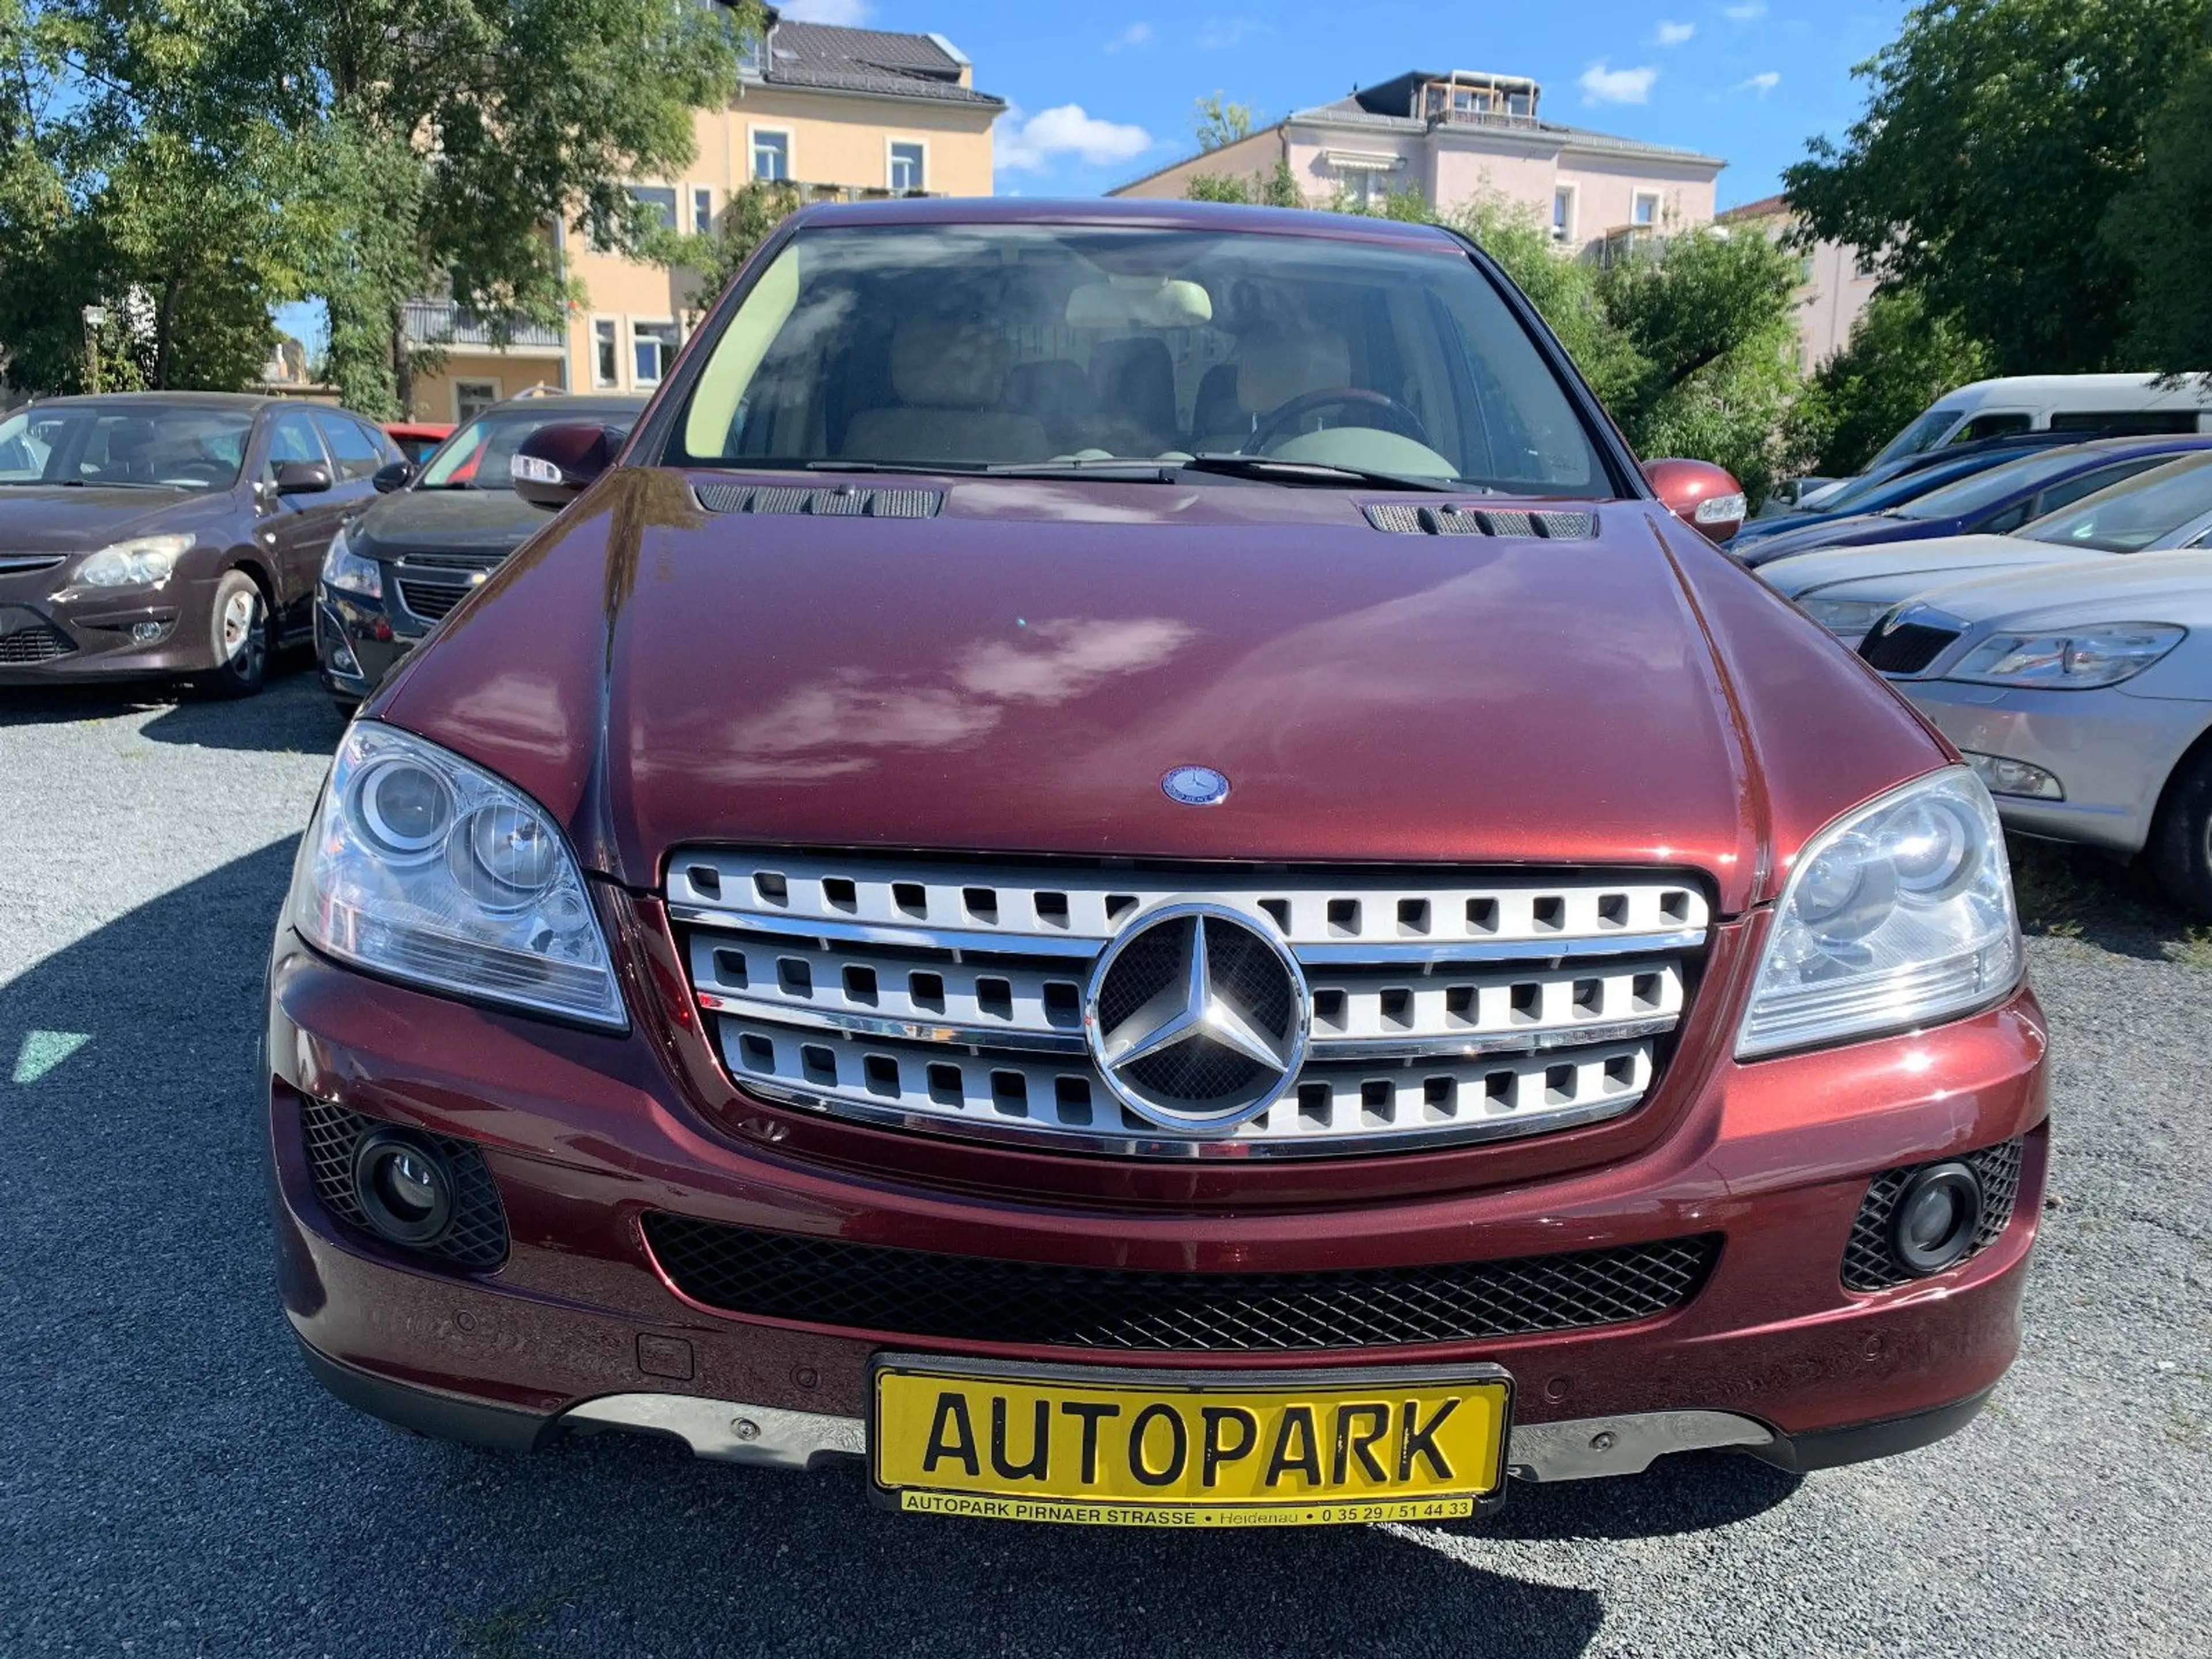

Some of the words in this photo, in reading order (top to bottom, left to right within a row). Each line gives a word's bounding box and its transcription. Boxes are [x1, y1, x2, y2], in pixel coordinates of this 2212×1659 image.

[922, 1392, 1460, 1487] AUTOPARK
[907, 1495, 1009, 1516] AUTOPARK
[1016, 1505, 1100, 1521] PIRNAER
[1107, 1510, 1195, 1525] STRASSE
[1323, 1509, 1331, 1521] 0
[1338, 1508, 1357, 1521] 35
[1363, 1506, 1383, 1520] 29
[1399, 1505, 1418, 1517] 51
[1424, 1503, 1444, 1516] 44
[1449, 1502, 1468, 1514] 33
